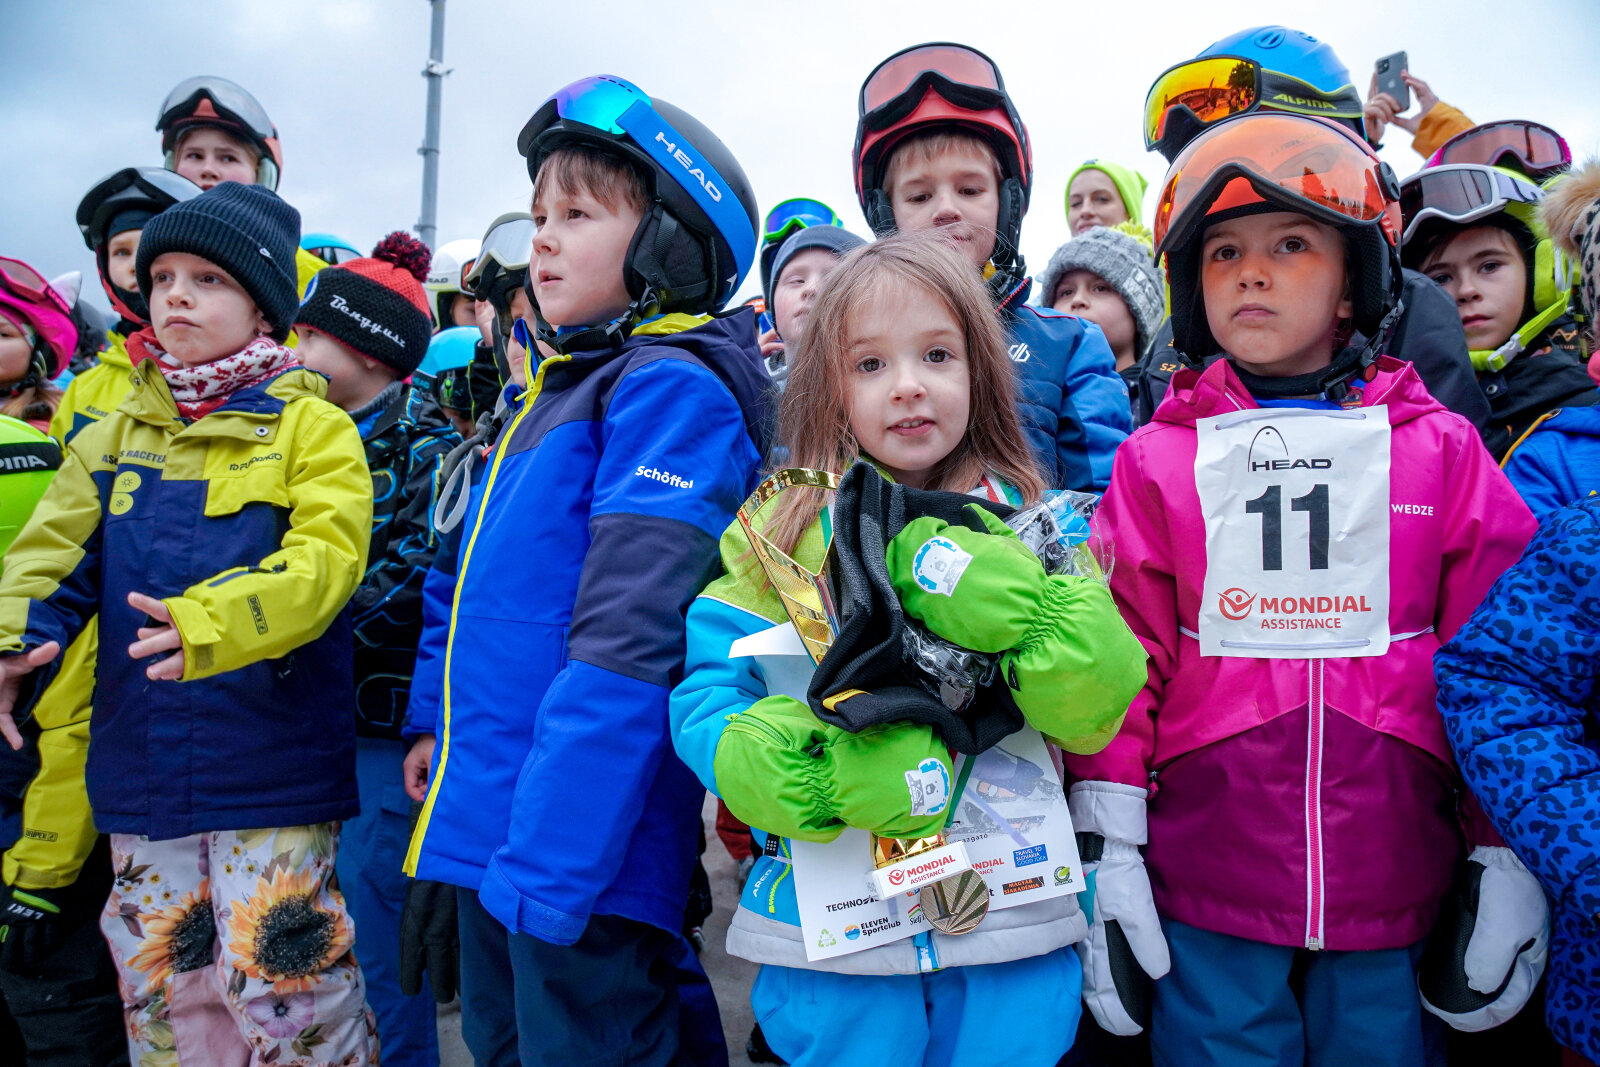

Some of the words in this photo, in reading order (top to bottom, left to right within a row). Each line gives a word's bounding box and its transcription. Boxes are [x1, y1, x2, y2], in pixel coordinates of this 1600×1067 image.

[1273, 93, 1337, 110] ALPINA
[655, 131, 722, 203] HEAD
[1252, 458, 1332, 472] HEAD
[635, 465, 694, 489] Schöffel
[1391, 503, 1434, 516] WEDZE
[1245, 483, 1330, 571] 11
[1260, 595, 1372, 614] MONDIAL
[1261, 618, 1342, 630] ASSISTANCE
[1015, 849, 1034, 857] TRAVEL
[1015, 852, 1040, 861] SLOVAKIA
[907, 855, 956, 877] MONDIAL
[910, 868, 945, 885] ASSISTANCE
[1008, 878, 1033, 888] MAGYAR
[7, 903, 45, 919] LEKI
[860, 917, 889, 930] ELEVEN
[862, 920, 901, 937] Sportclub
